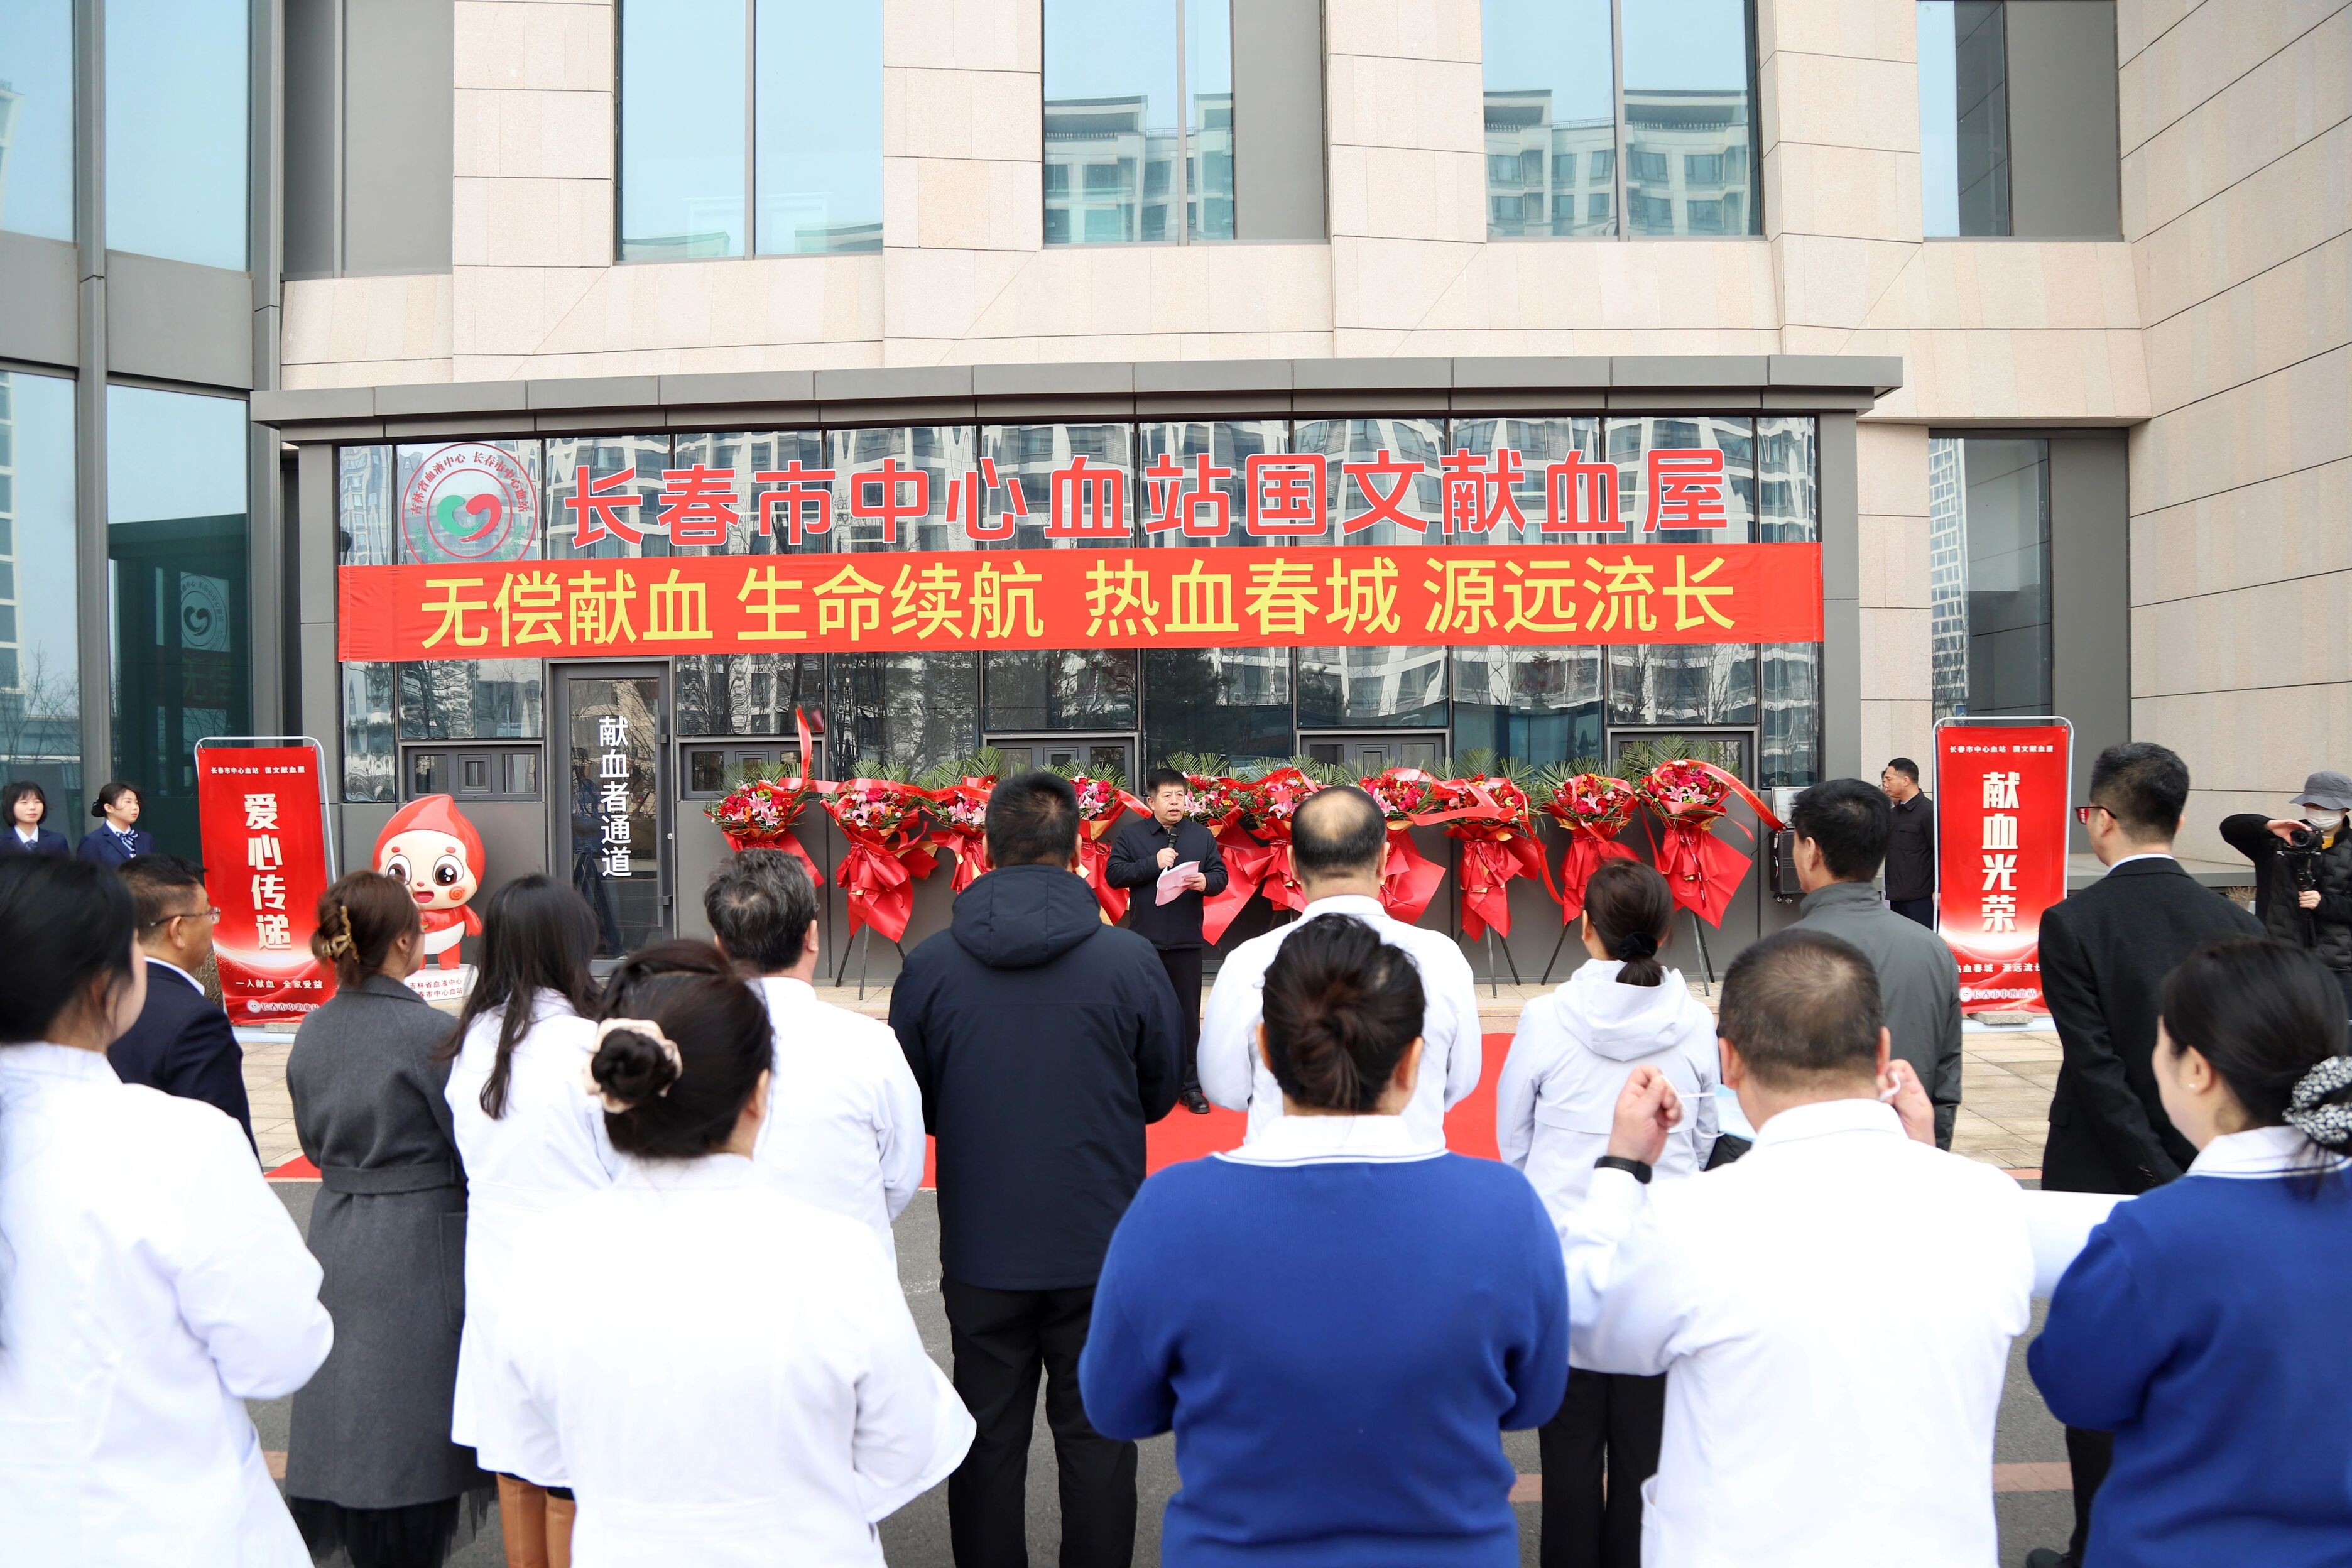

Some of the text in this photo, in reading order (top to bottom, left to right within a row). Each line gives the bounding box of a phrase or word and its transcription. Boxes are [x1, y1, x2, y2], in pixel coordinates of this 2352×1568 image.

[410, 450, 530, 514] 吉林省血液中心 长春市中心血站
[564, 447, 1729, 548] 长春市中心血站国文献血屋
[421, 555, 1736, 650] 无偿献血 生命续航 热血春城 源远流长
[211, 765, 305, 775] 长春市中心血站 国文献血屋
[1949, 745, 2006, 753] 长春市中心血站
[599, 716, 632, 877] 献血者通道
[244, 793, 292, 950] 爱心传递
[1981, 771, 2020, 932] 献血光荣
[236, 979, 323, 989] 一人献血 全家受益
[410, 979, 462, 989] 吉林省血液中心
[418, 988, 463, 998] 春市中心血站
